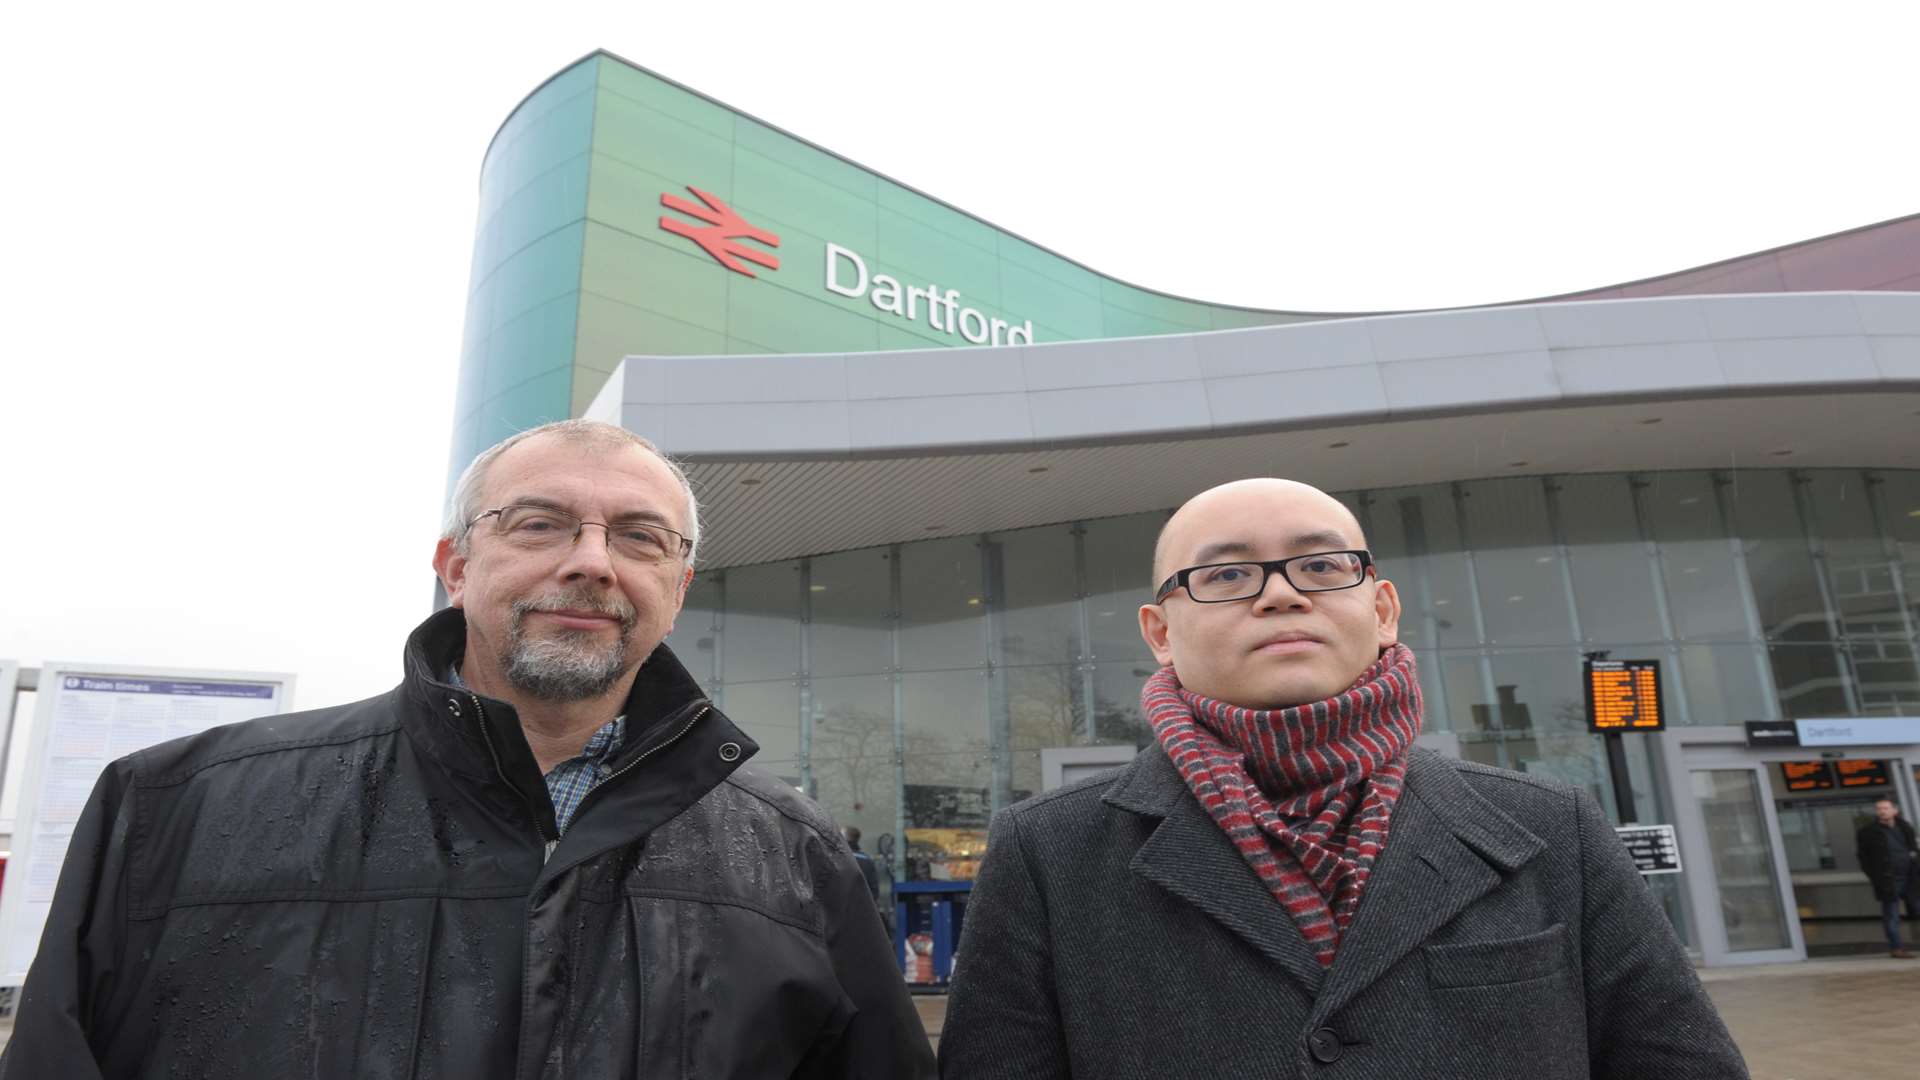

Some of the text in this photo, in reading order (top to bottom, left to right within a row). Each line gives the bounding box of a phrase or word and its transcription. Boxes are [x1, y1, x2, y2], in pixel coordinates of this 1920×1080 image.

[824, 242, 1033, 347] Dartford
[82, 679, 151, 692] Train times
[1807, 726, 1852, 737] Dartford
